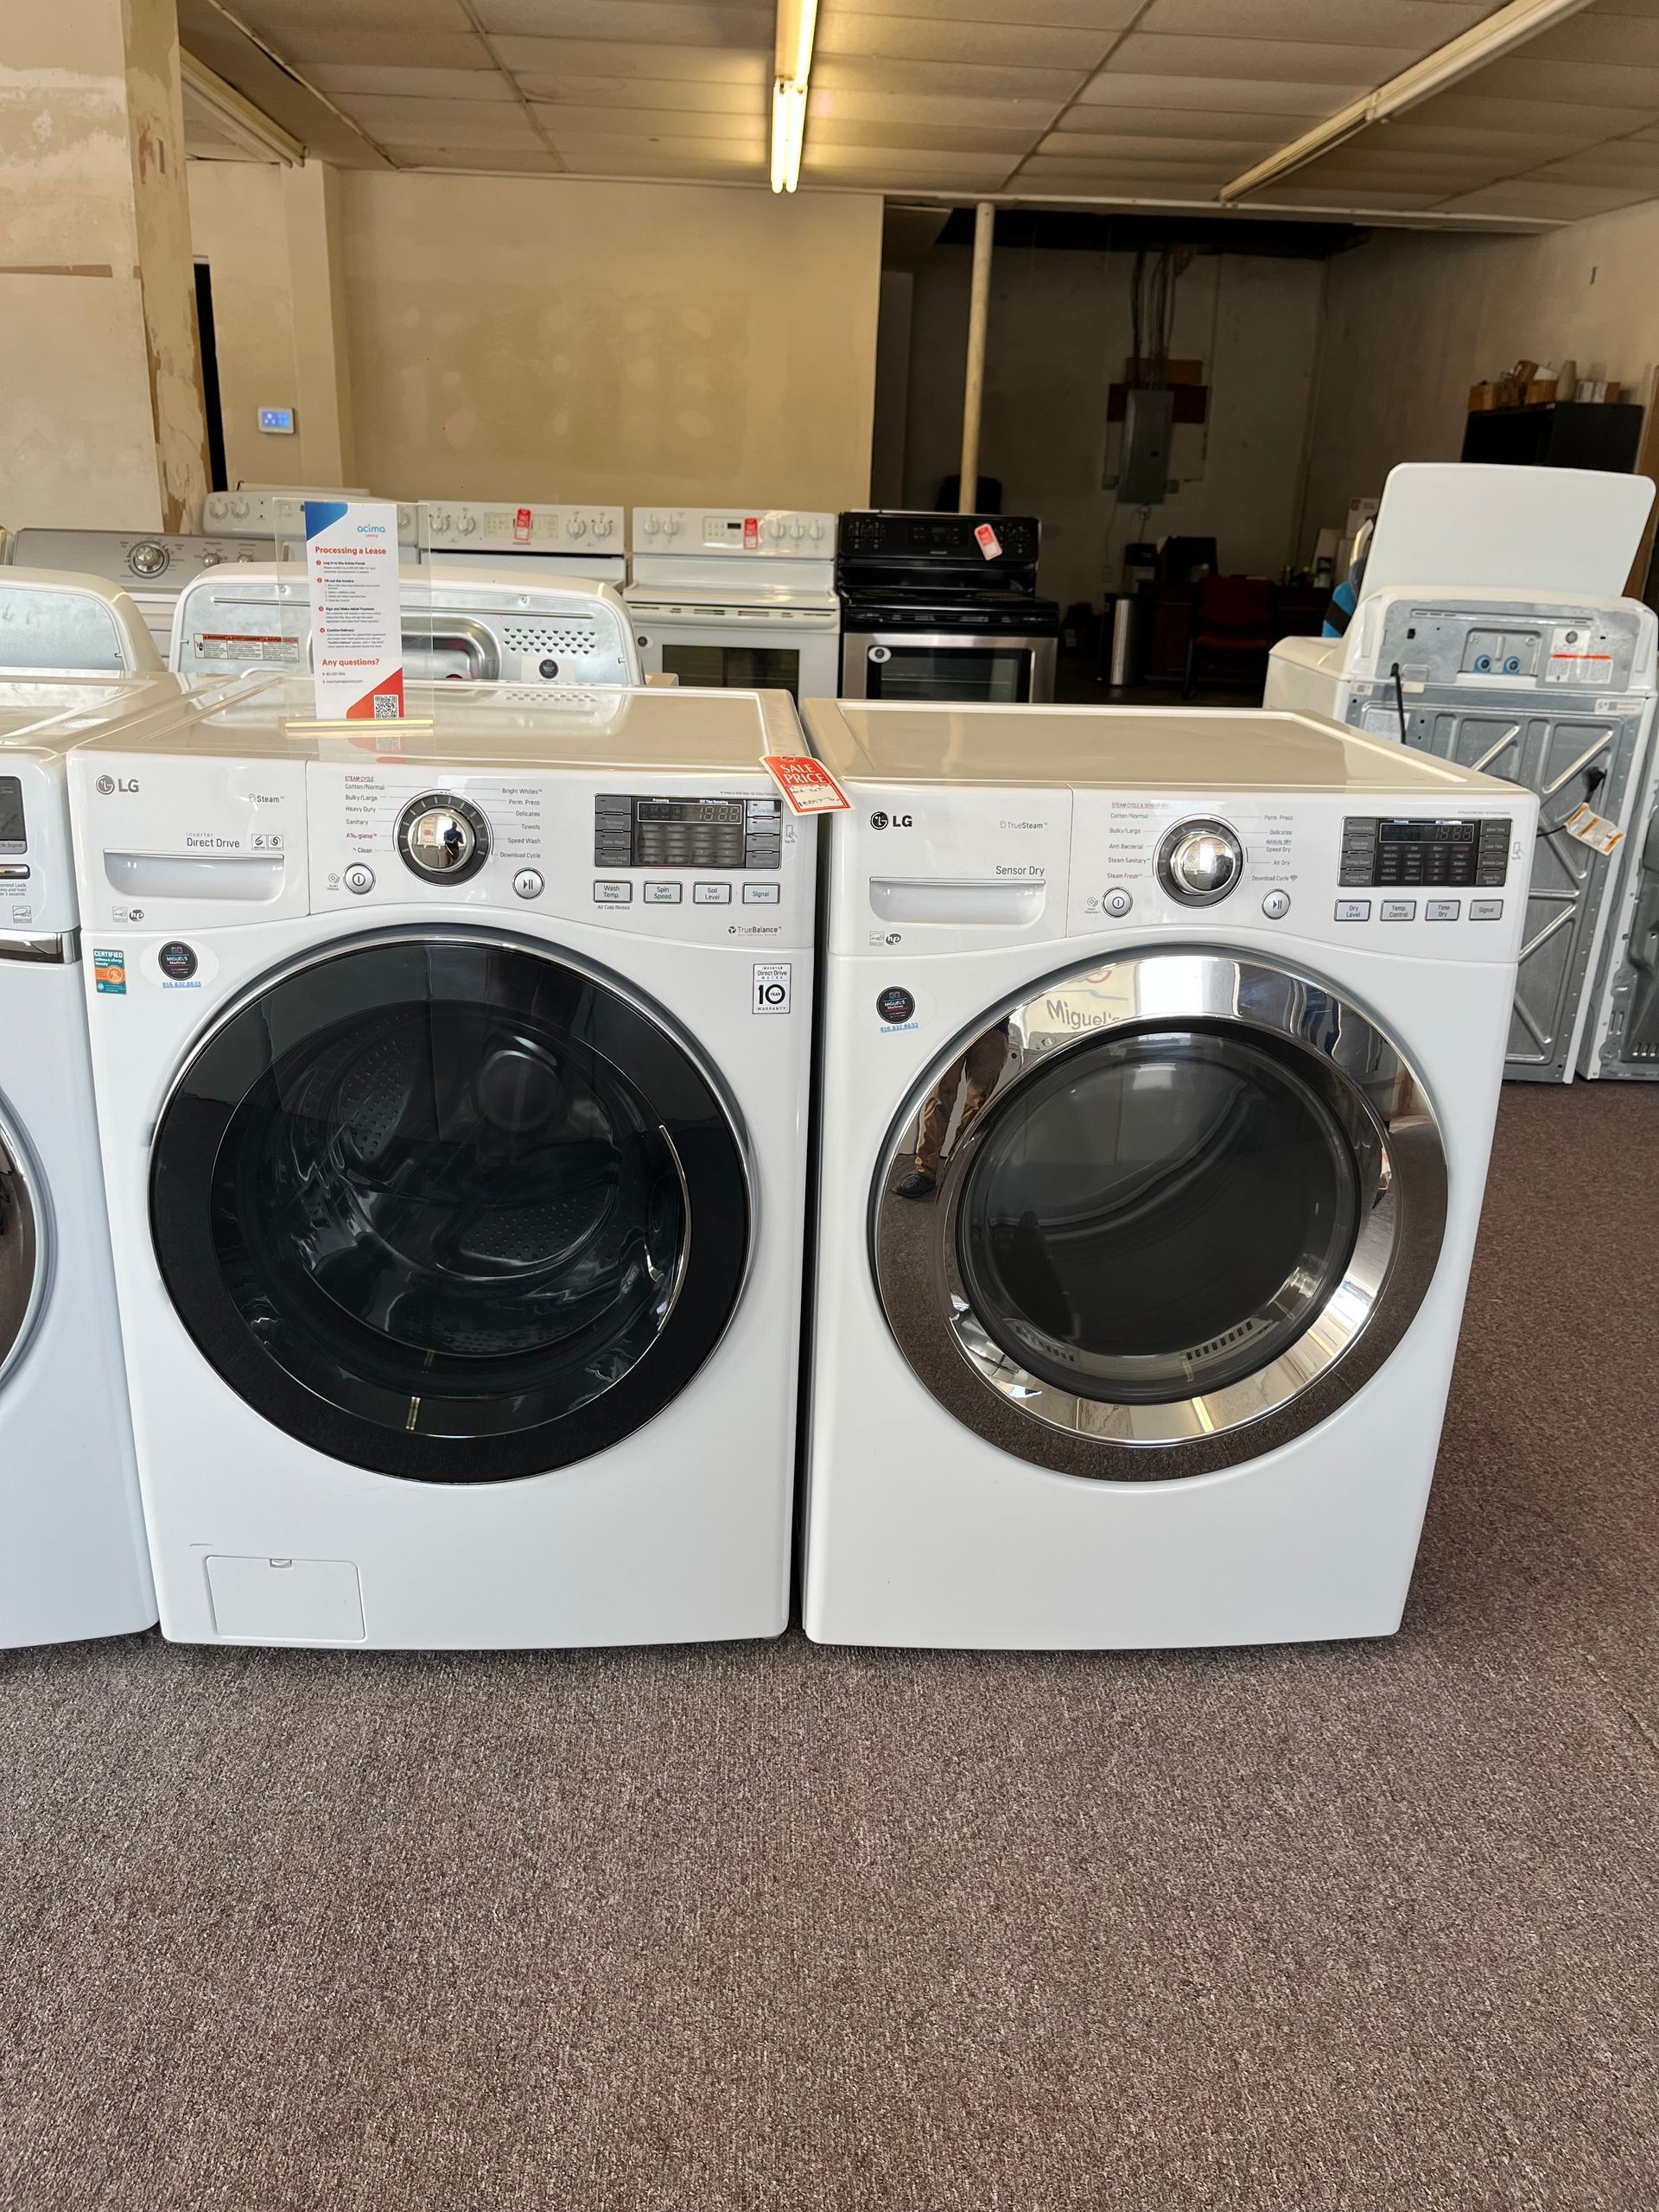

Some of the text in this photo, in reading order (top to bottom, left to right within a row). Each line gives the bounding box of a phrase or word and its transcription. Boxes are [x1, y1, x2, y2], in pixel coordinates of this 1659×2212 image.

[357, 524, 385, 532] acima
[315, 546, 357, 555] Processing
[780, 764, 816, 773] SALE
[784, 773, 827, 784] PRICE
[118, 779, 139, 793] LG
[893, 815, 912, 828] LG
[187, 838, 240, 848] Direct Drive
[995, 866, 1046, 877] Sensor Dry
[759, 984, 785, 1004] 10
